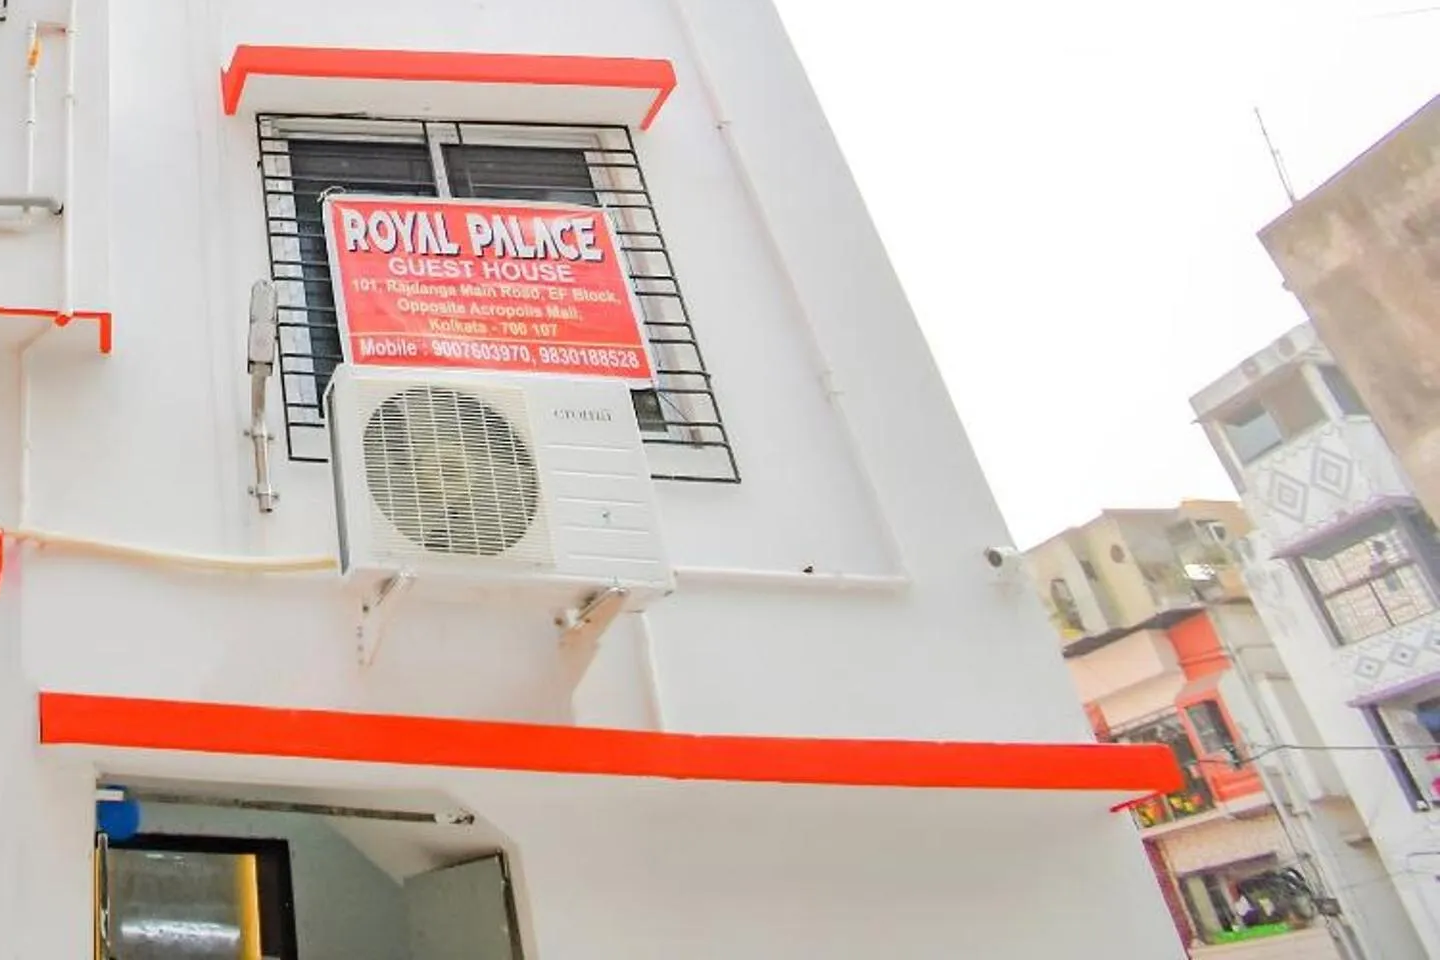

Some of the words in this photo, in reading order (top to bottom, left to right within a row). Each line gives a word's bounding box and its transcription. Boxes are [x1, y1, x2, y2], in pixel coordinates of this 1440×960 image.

[342, 208, 460, 256] ROYAL
[466, 213, 604, 261] PALACE
[389, 257, 474, 279] GUEST
[484, 260, 576, 283] HOUSE
[460, 283, 496, 297] Main
[397, 298, 465, 314] Opposite
[470, 302, 542, 319] Acropolis
[428, 317, 488, 334] Kolkata
[500, 322, 527, 336] 700
[360, 338, 417, 357] Mobile
